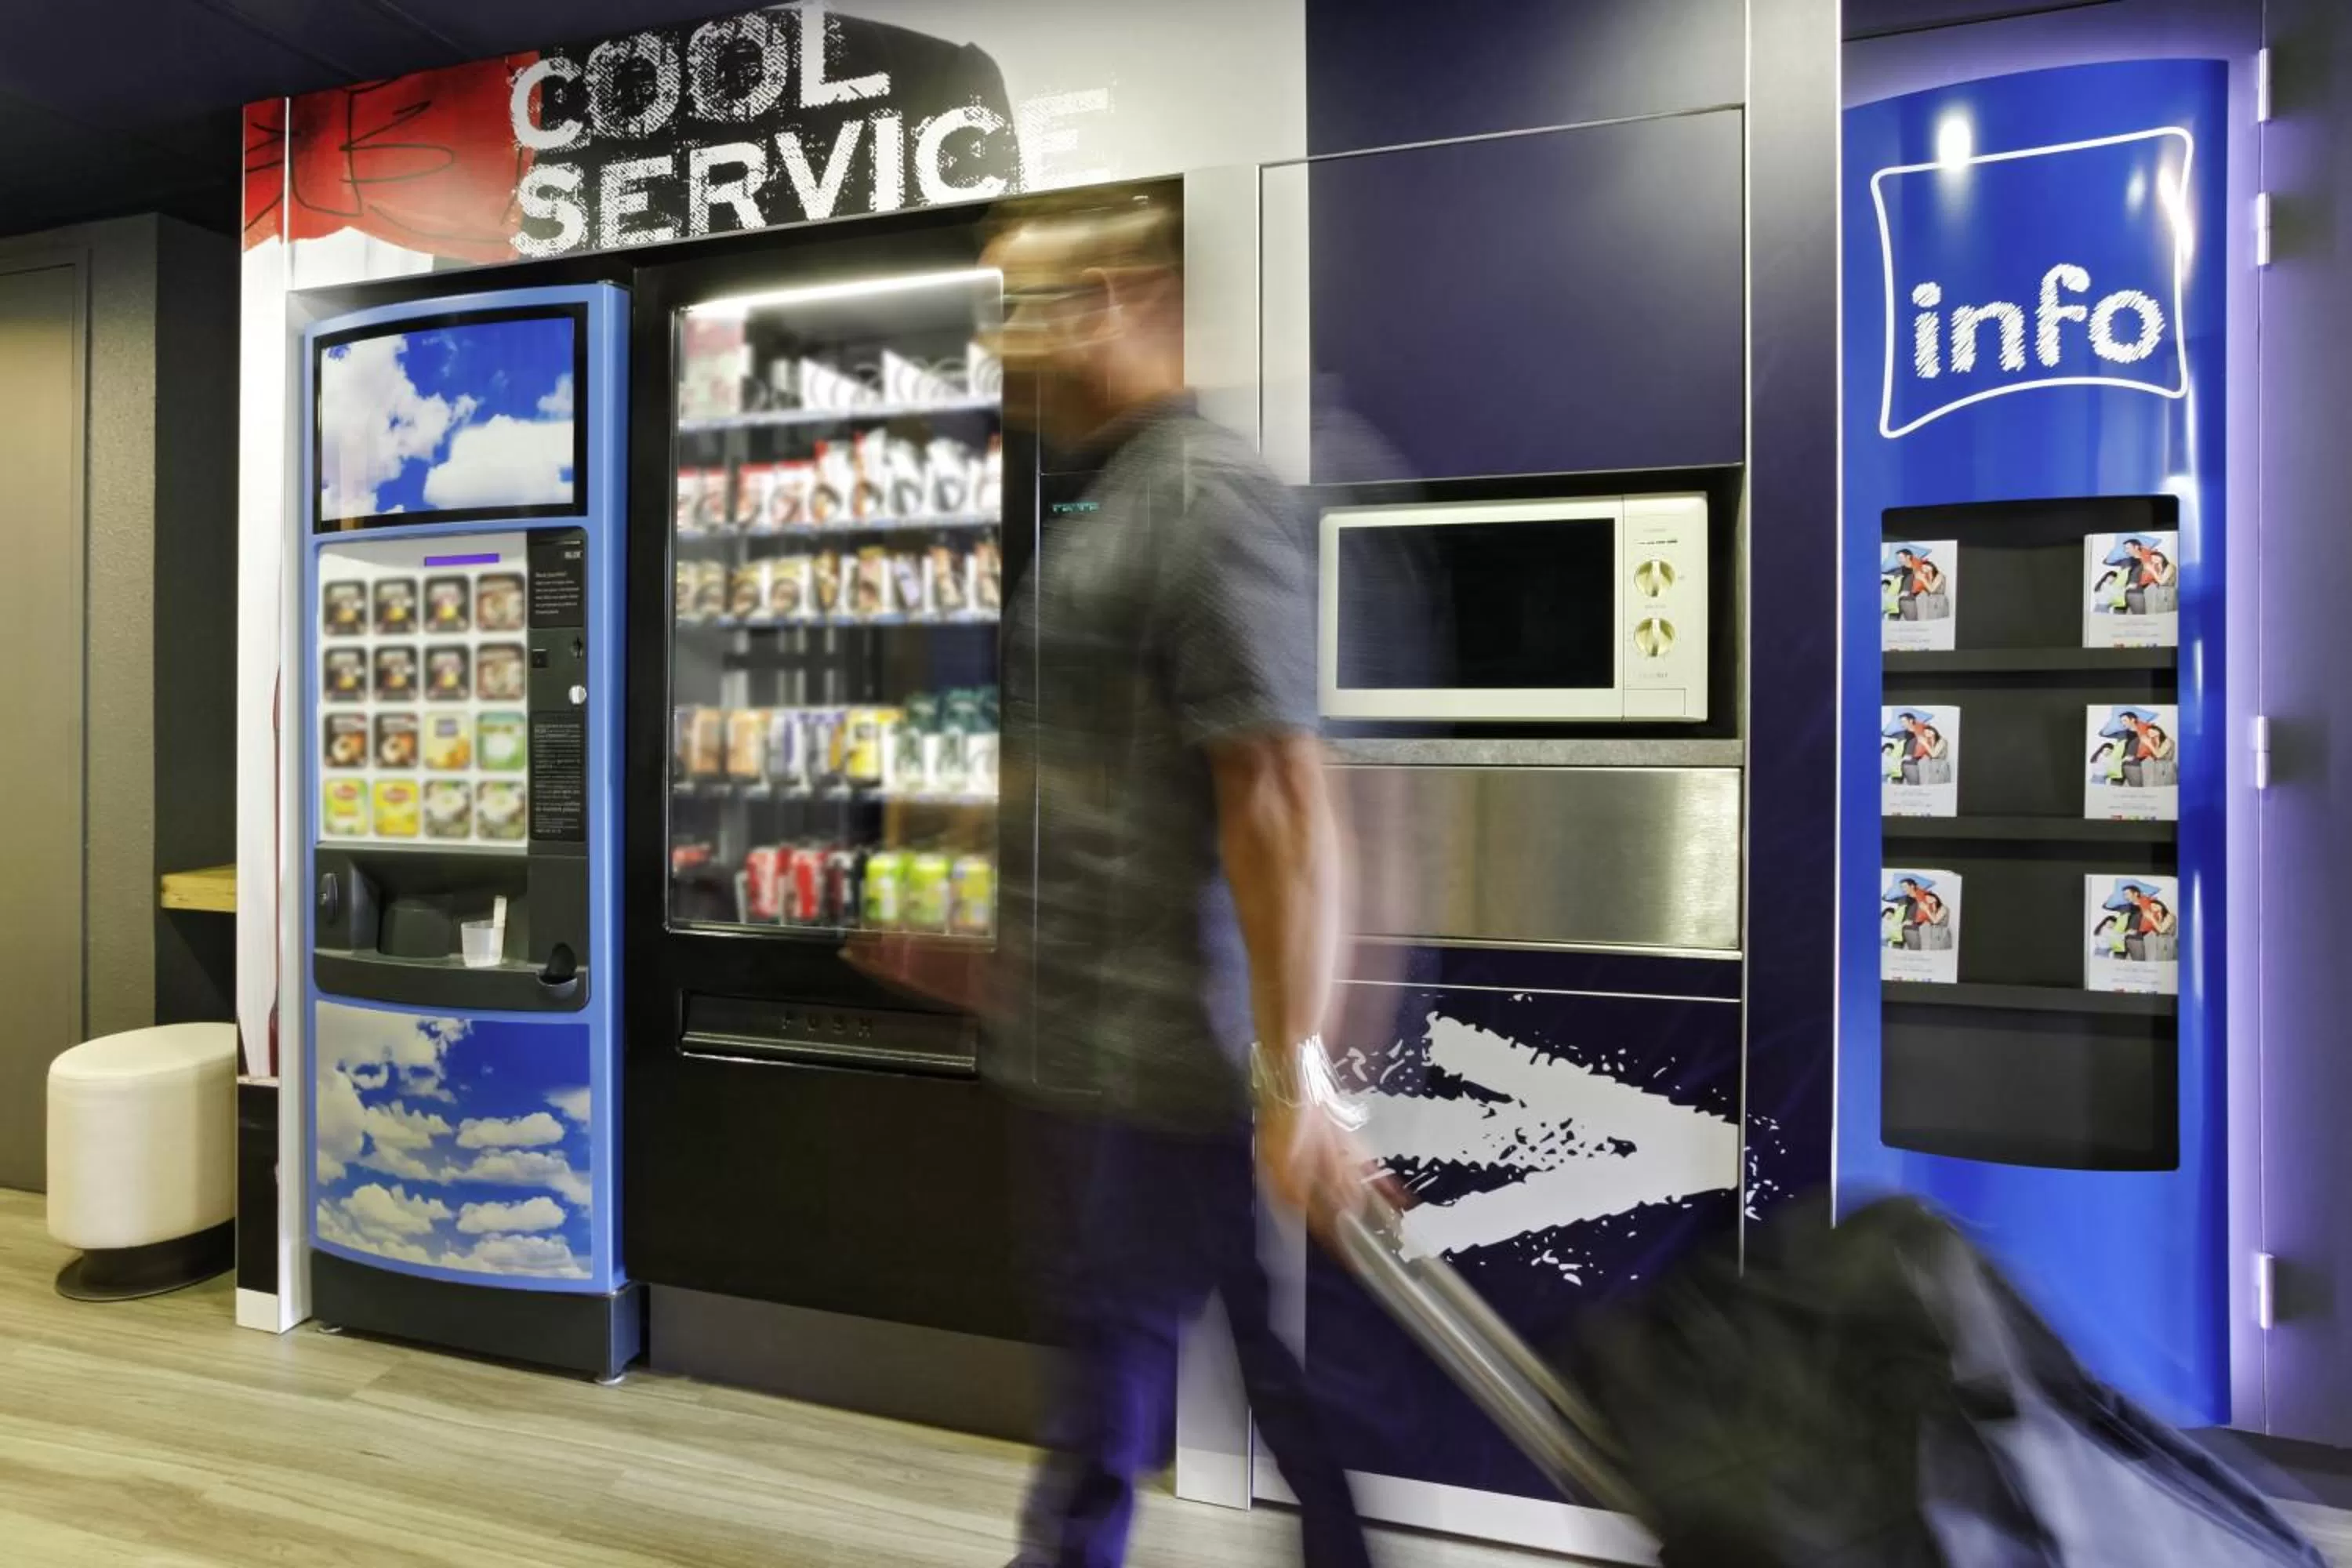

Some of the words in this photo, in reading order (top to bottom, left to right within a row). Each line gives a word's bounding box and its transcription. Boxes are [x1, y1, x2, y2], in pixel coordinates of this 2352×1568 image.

[510, 0, 891, 151] COOL
[509, 87, 1112, 257] SERVICE
[1911, 263, 2165, 379] info
